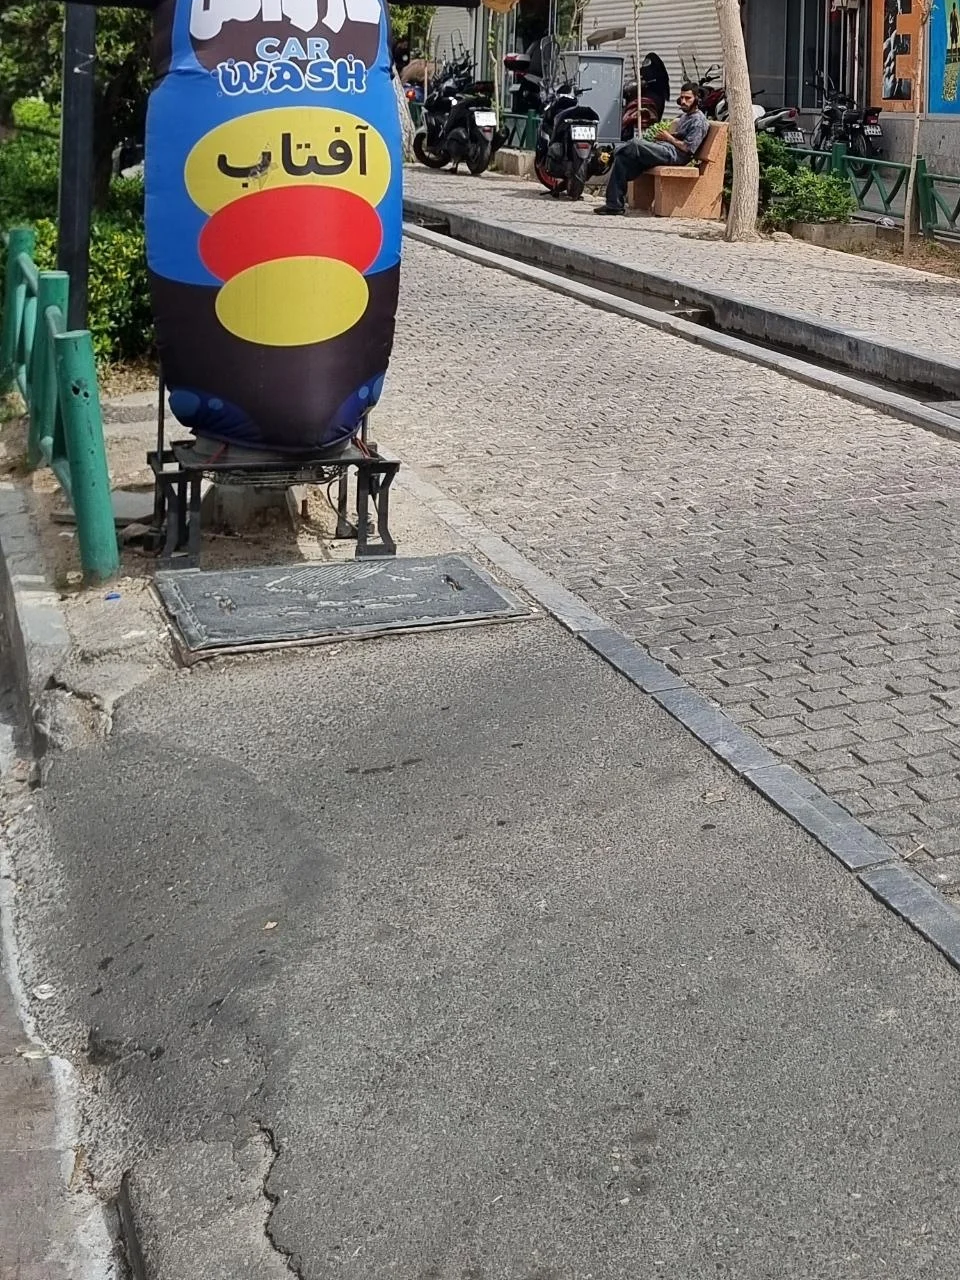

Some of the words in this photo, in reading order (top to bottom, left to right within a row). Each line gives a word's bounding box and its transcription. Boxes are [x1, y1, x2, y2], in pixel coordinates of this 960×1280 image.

[255, 37, 331, 61] CAR
[217, 58, 368, 96] WASH
[217, 124, 369, 188] آفتاب
